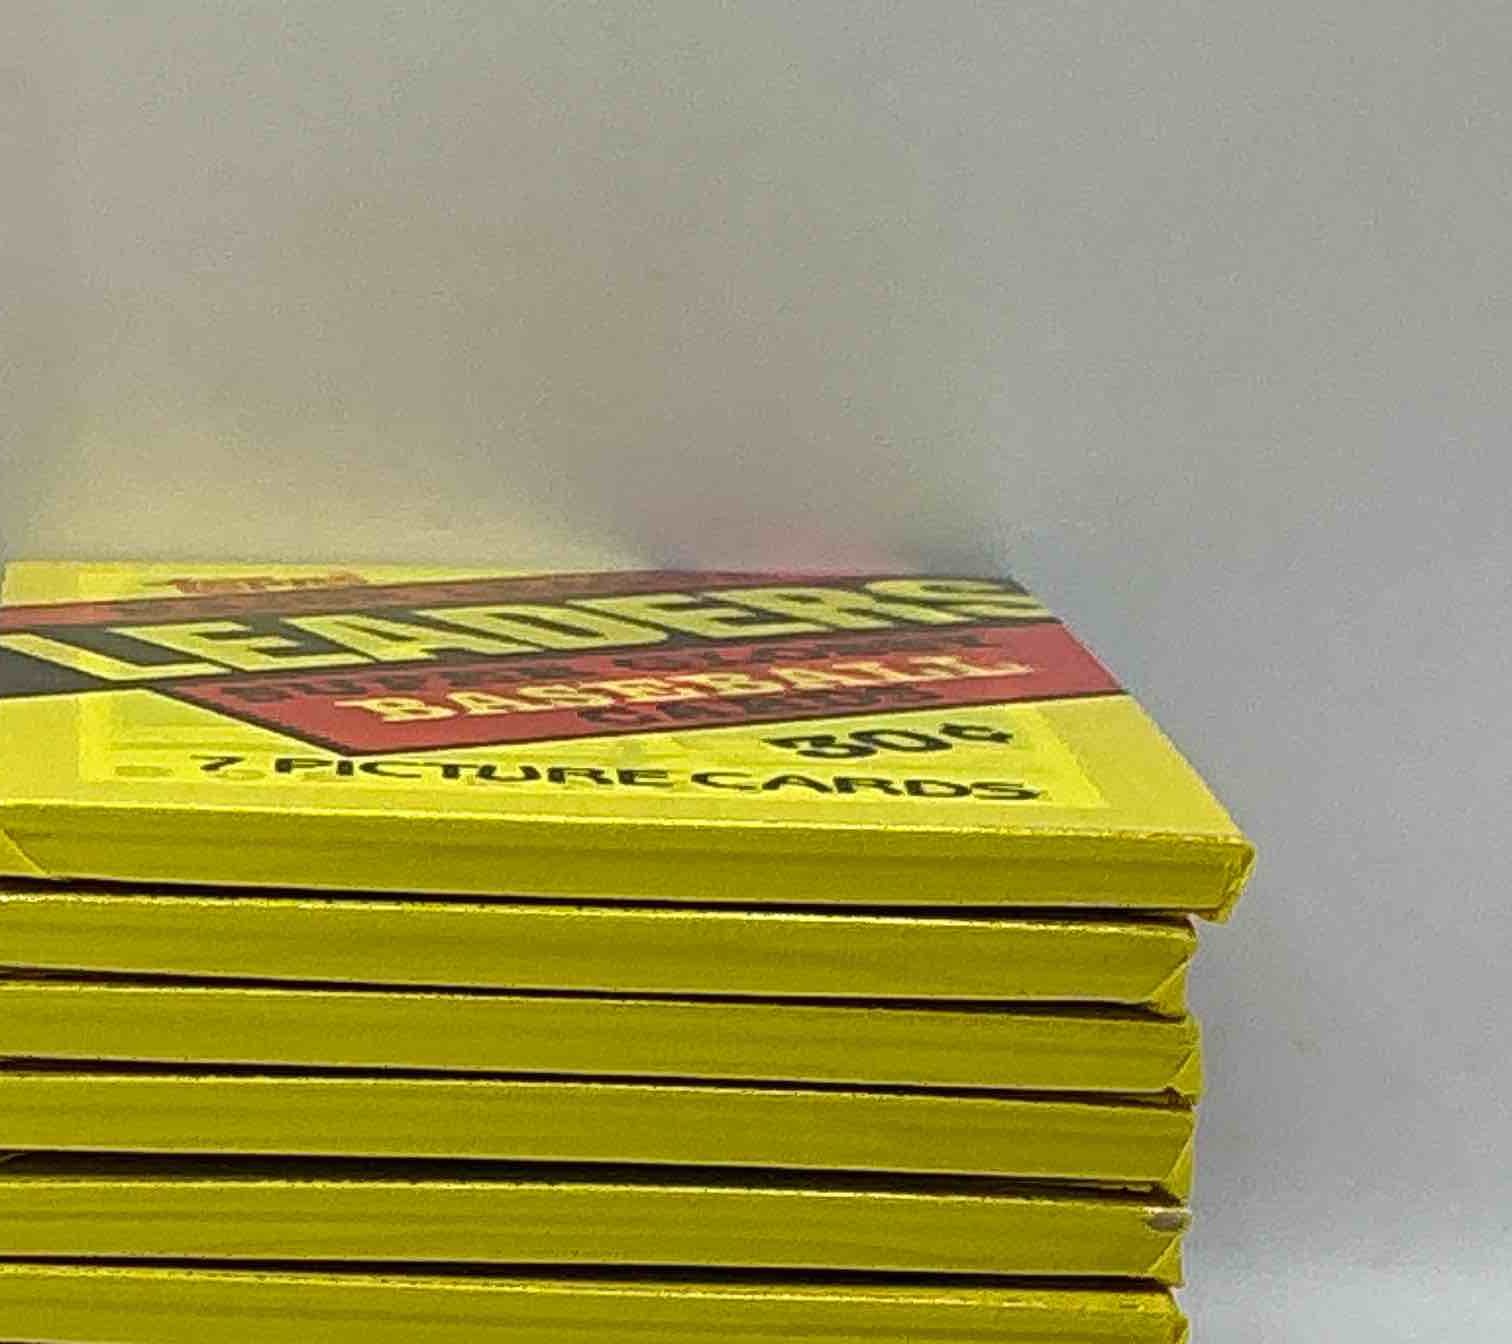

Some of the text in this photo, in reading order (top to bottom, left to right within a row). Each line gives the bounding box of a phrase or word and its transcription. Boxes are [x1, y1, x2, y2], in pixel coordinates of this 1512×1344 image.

[334, 654, 1032, 722] BASEBALL
[189, 755, 244, 773] 7
[274, 756, 674, 786] PICTURE
[690, 771, 1041, 801] CARDS
